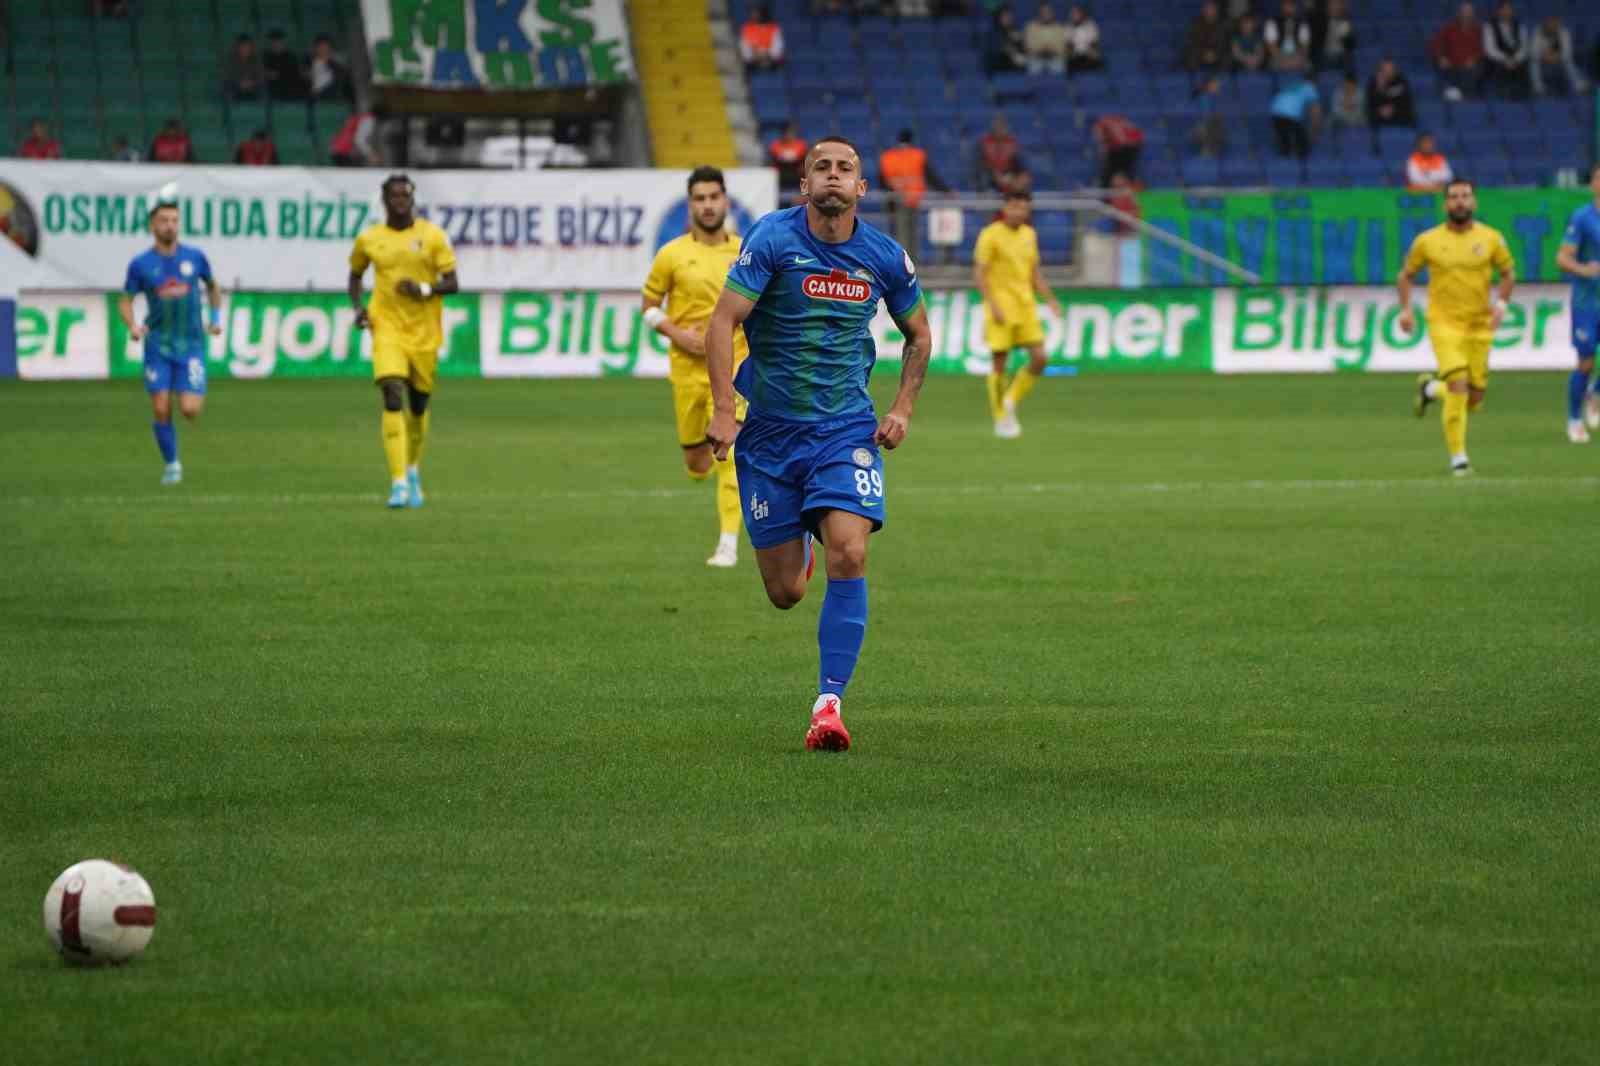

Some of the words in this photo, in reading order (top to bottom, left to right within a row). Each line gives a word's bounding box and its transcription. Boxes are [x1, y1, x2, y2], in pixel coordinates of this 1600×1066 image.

[44, 194, 268, 239] OSMALI'DA
[418, 204, 541, 247] ZZEDE
[557, 195, 645, 248] BİZİZ
[808, 278, 865, 298] ÇAYKUR
[1233, 285, 1563, 370] Bilyoer
[854, 468, 883, 498] 89
